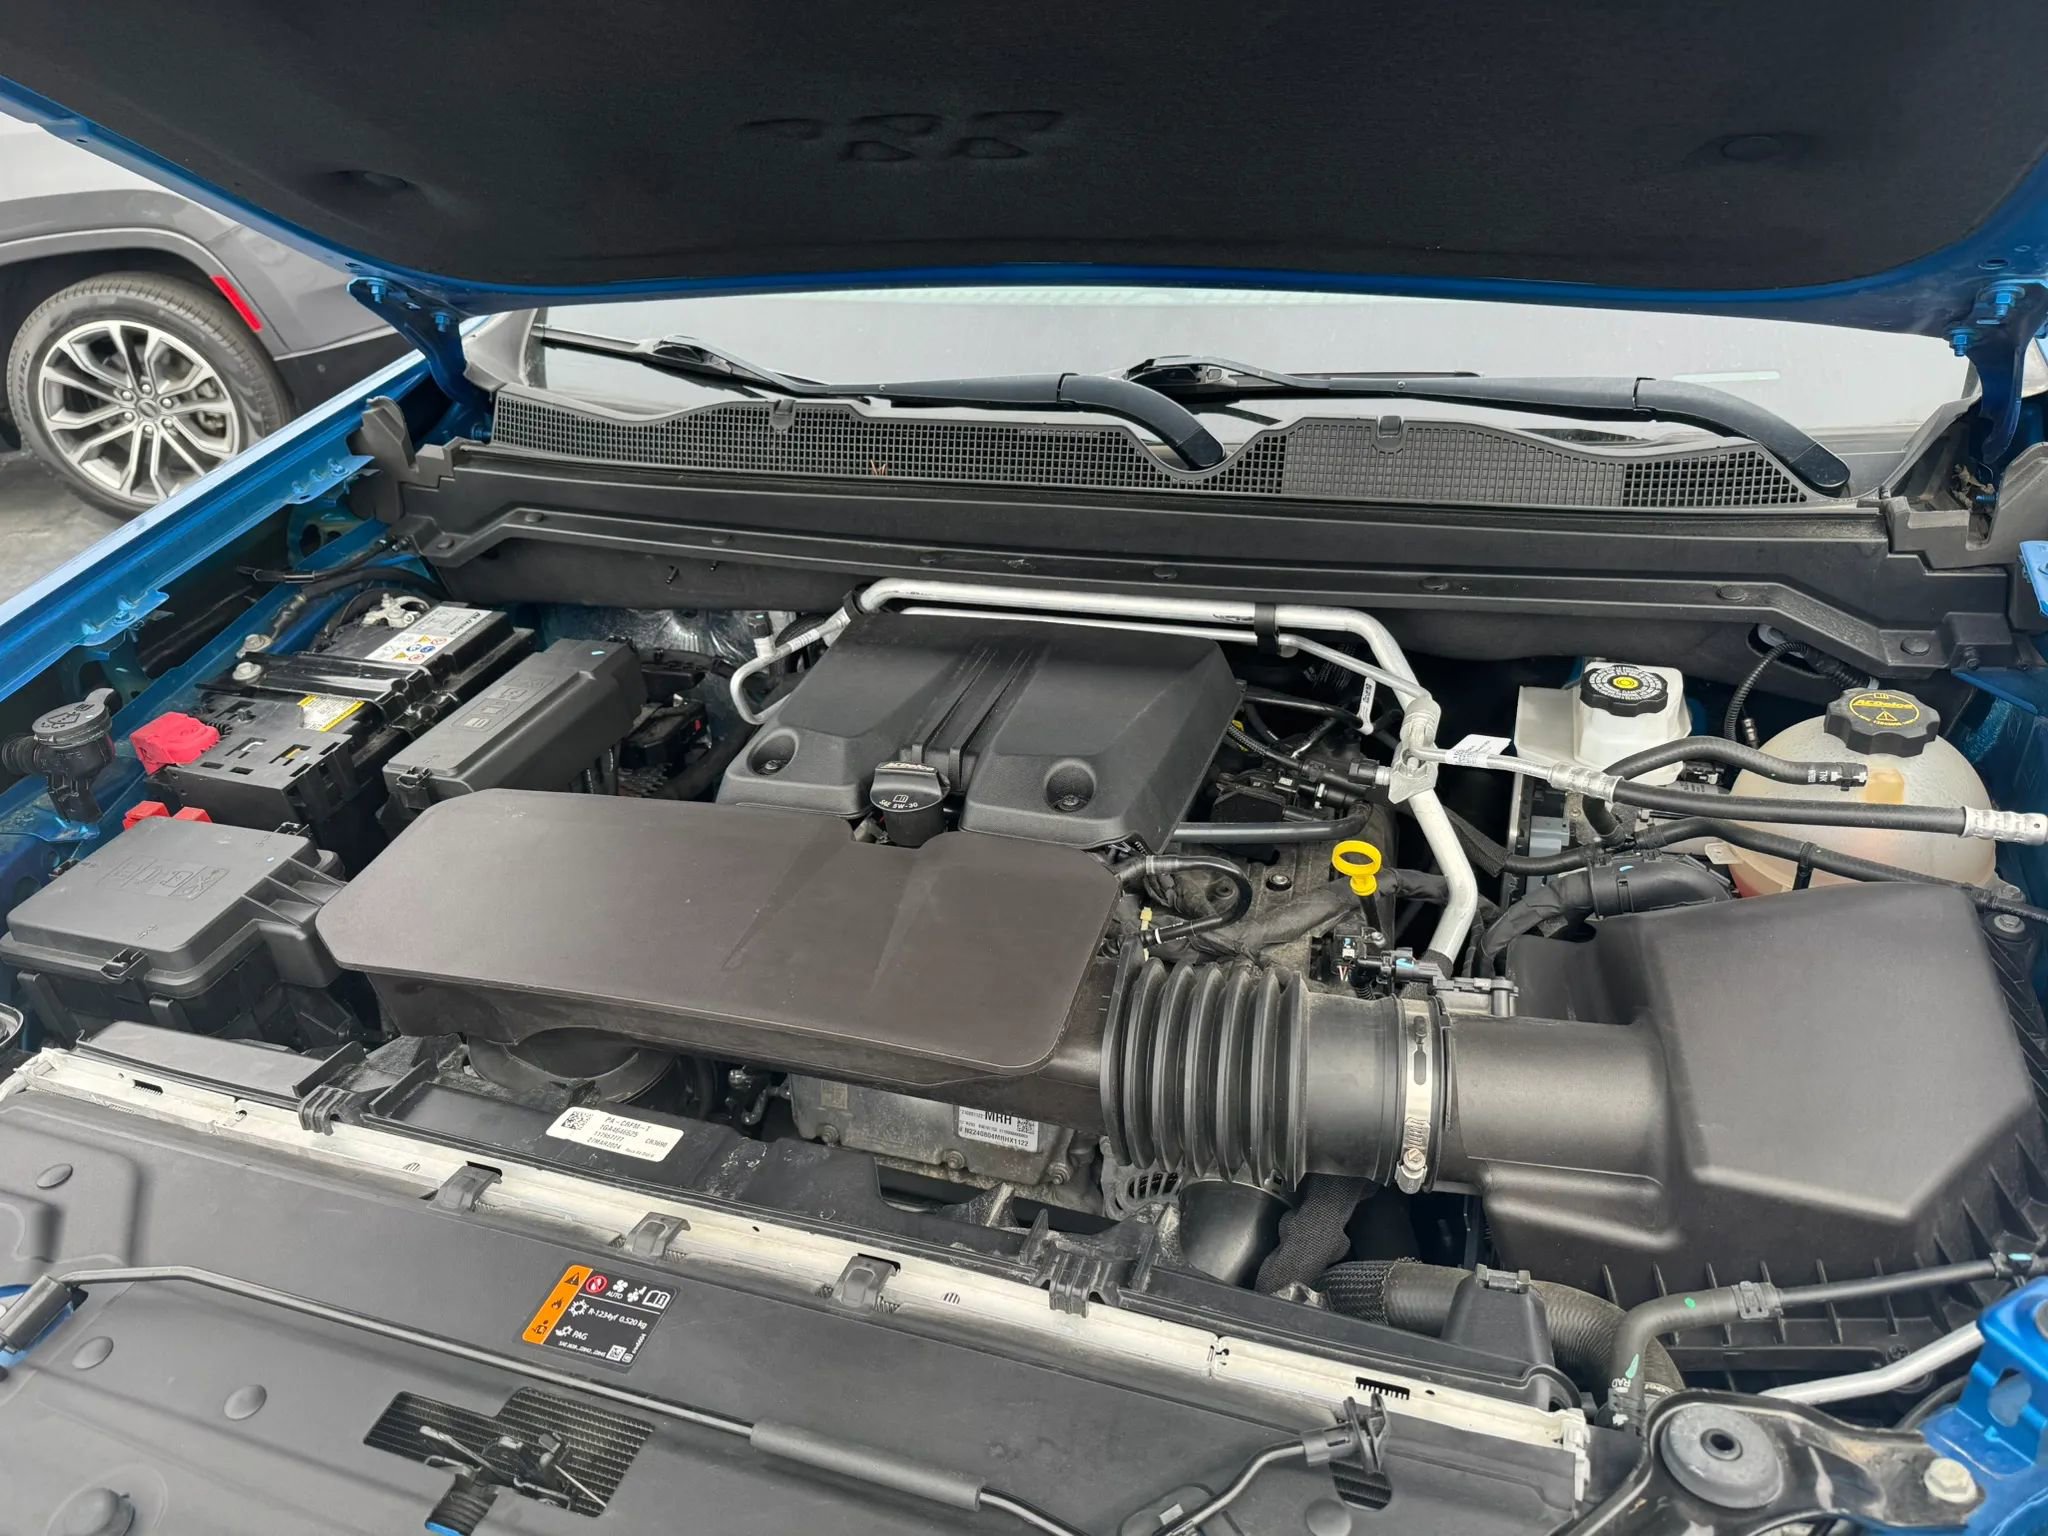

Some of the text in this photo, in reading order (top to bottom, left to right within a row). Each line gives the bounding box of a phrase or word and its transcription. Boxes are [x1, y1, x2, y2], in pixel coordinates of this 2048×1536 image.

[879, 799, 892, 808] SAE
[605, 1291, 624, 1300] AUTO
[587, 1307, 648, 1331] R-1234yf 0.520 kg
[571, 1330, 588, 1341] PAG
[1611, 1377, 1631, 1388] RAD
